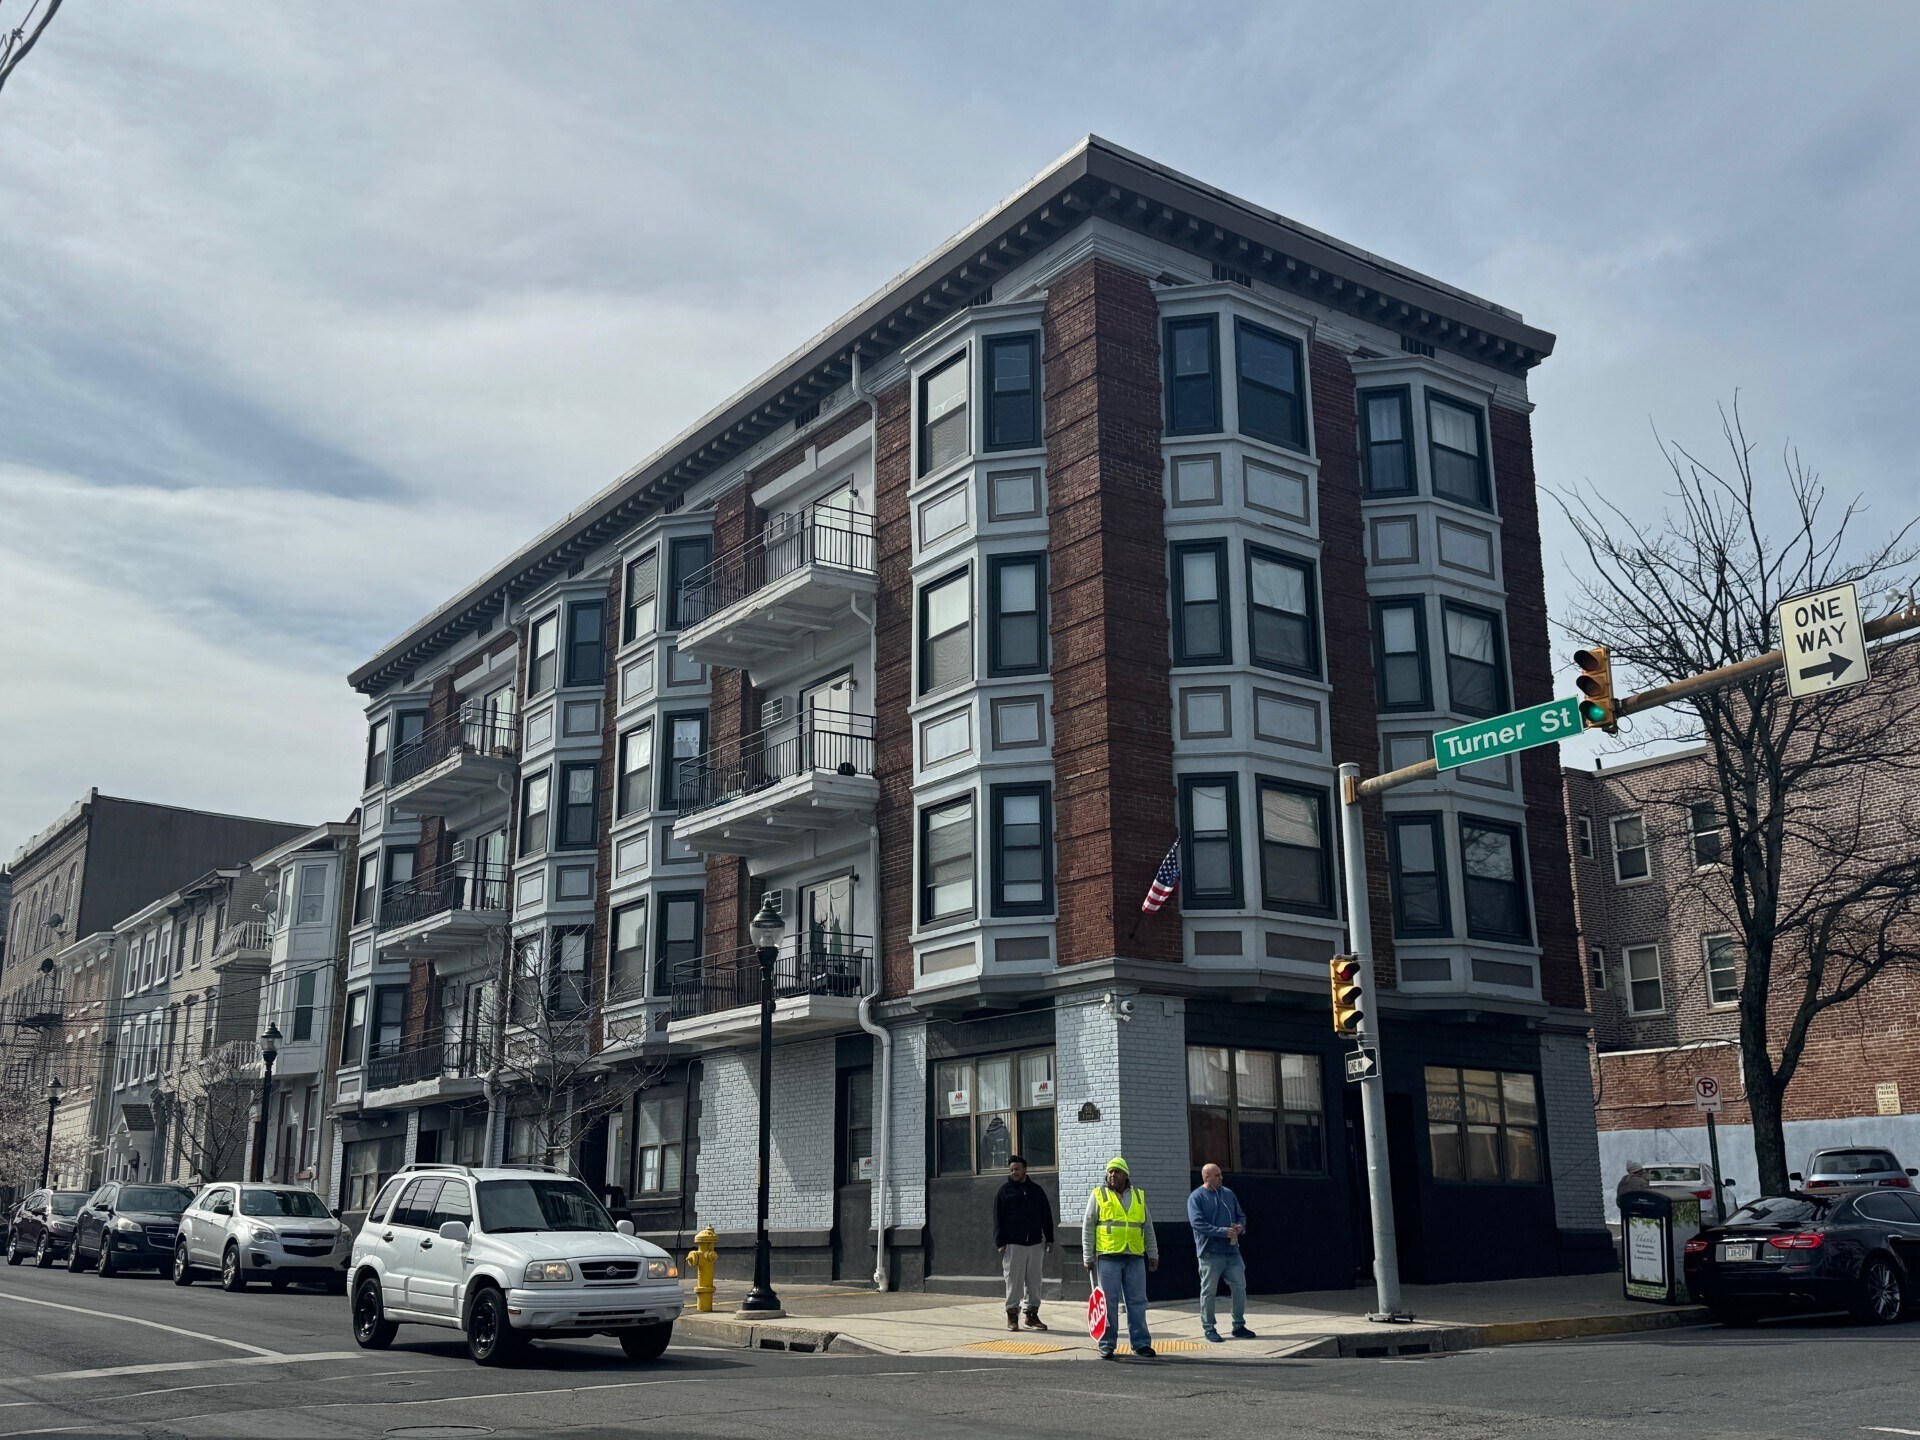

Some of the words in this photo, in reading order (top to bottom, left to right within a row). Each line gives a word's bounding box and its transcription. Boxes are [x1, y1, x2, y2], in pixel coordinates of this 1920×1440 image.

[1795, 597, 1843, 627] ONE
[1796, 621, 1847, 653] WAY
[1443, 723, 1525, 757] Turner
[1541, 708, 1572, 733] St
[1090, 1297, 1105, 1331] STOP
